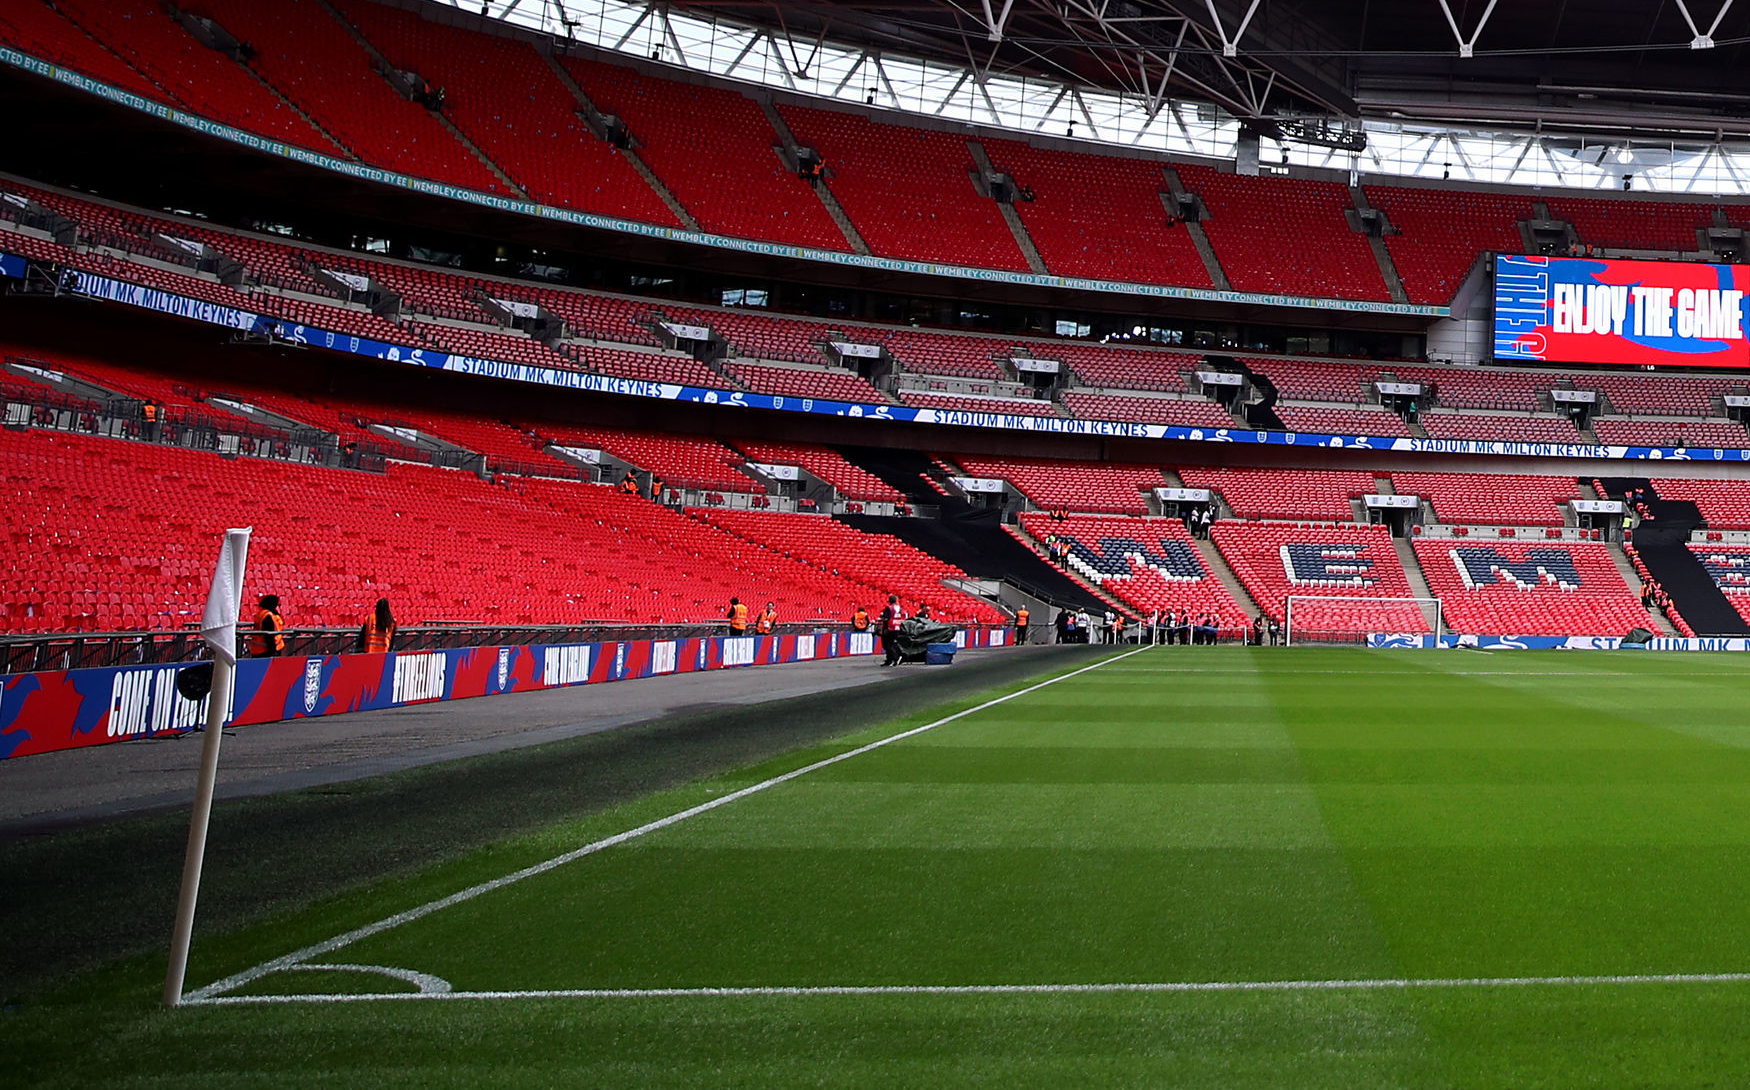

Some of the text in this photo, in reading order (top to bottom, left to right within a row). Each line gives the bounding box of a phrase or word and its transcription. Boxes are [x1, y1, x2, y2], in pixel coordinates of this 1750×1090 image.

[53, 67, 96, 92] WEMBLEY
[96, 83, 144, 109] CONNECTED
[172, 109, 211, 133] WEMBLEY
[211, 123, 258, 148] CONNECTED
[289, 147, 330, 169] WEMBLEY
[330, 159, 381, 181] CONNECTED
[413, 178, 456, 198] WEMBLEY
[456, 188, 508, 209] CONNECTED
[541, 206, 584, 223] WEMBLEY
[585, 215, 638, 233] CONNECTED
[671, 229, 716, 245] WEMBLEY
[716, 236, 769, 253] CONNECTED
[803, 249, 847, 263] WEMBLEY
[847, 255, 900, 270] CONNECTED
[143, 288, 188, 316] MILTON
[192, 300, 240, 326] KEYNES
[1553, 283, 1743, 339] ENJOY THE GAME
[462, 358, 519, 380] STADIUM
[553, 369, 602, 390] MILTON
[607, 377, 662, 397] KEYNES
[933, 410, 997, 426] STADIUM
[1034, 417, 1084, 433] MILTON
[1090, 421, 1148, 438] KEYNES
[1410, 438, 1470, 453] STADIUM
[1503, 442, 1551, 456] MILTON
[1556, 444, 1609, 457] KEYNES
[392, 652, 446, 703] #THREELIONS
[107, 671, 153, 737] COME
[151, 668, 176, 732] ON
